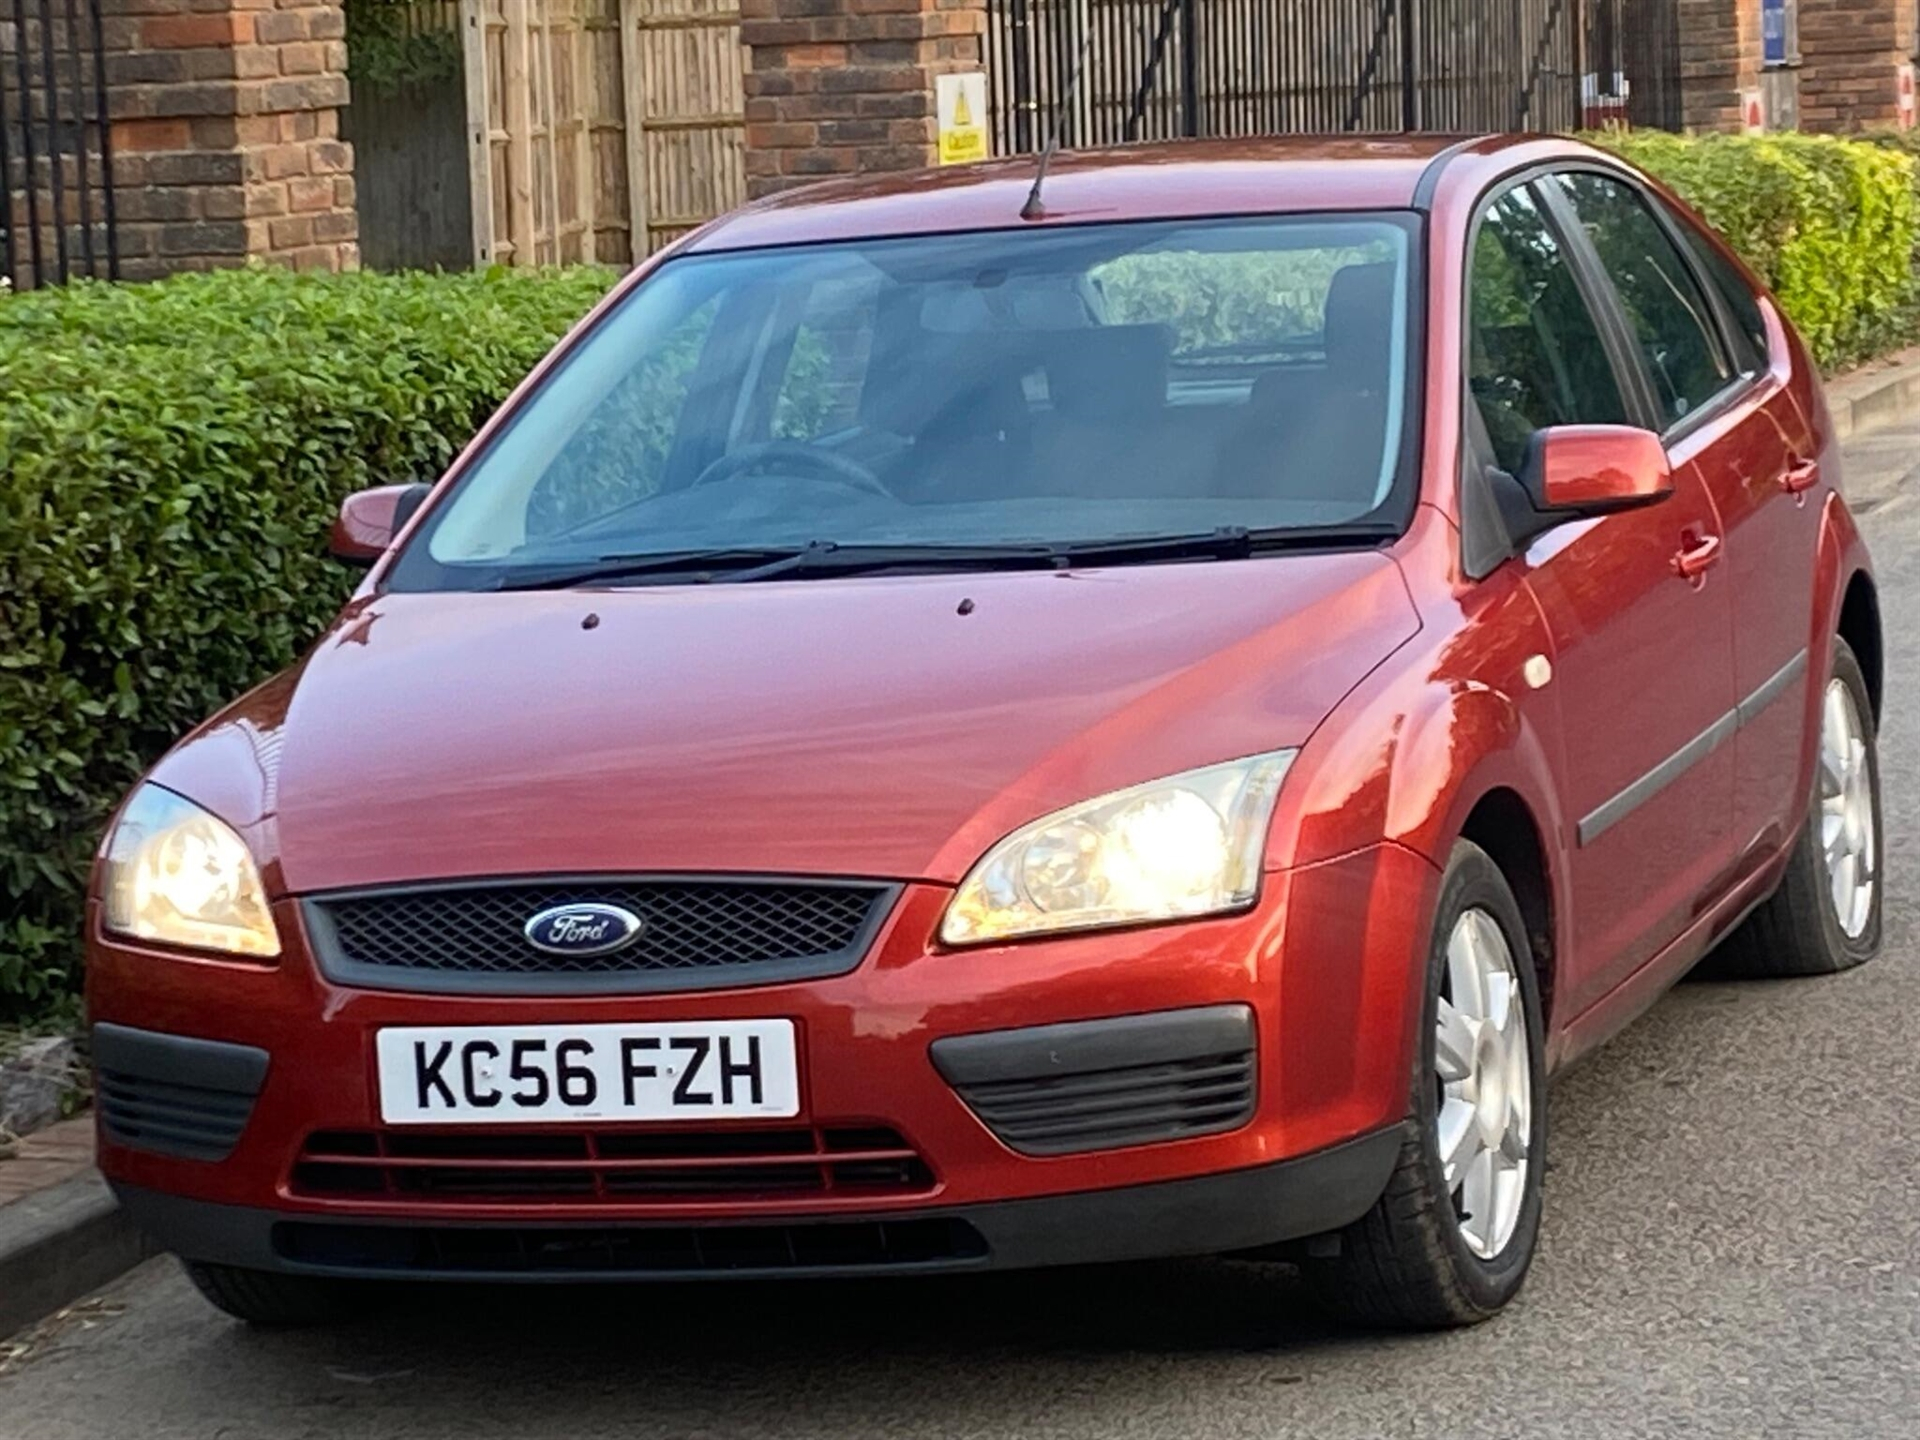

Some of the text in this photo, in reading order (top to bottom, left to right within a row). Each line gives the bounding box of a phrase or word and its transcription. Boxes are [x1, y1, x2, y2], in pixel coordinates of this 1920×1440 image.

[548, 914, 610, 943] Ford
[414, 1035, 764, 1109] KC56 FZH
